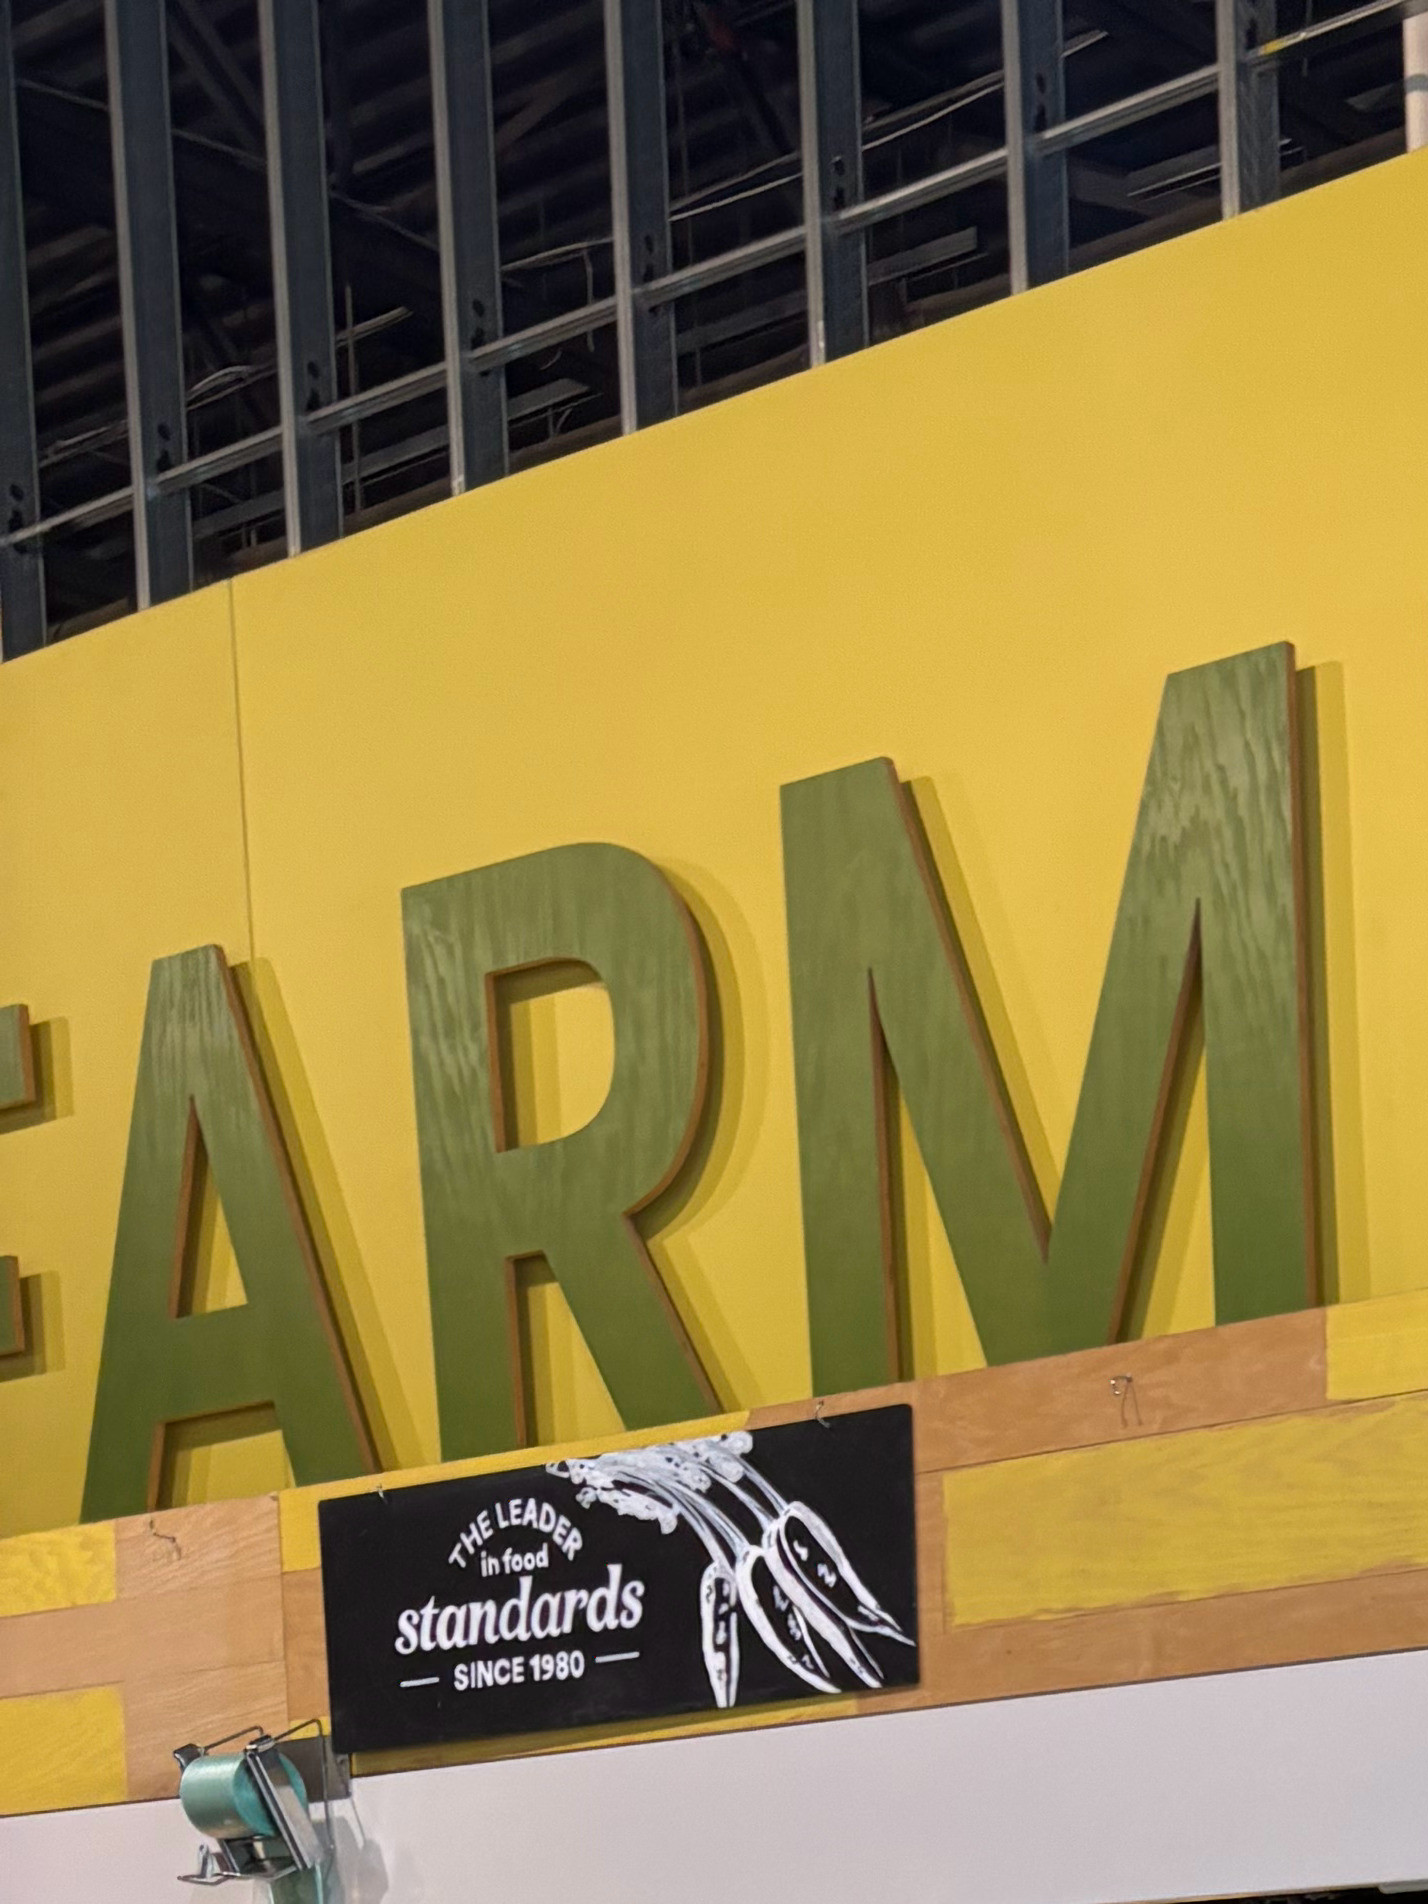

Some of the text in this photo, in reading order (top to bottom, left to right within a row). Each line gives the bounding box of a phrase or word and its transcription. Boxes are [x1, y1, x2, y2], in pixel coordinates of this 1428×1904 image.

[449, 1498, 584, 1569] THE LEADER
[480, 1544, 549, 1577] in food
[395, 1563, 646, 1655] standards
[453, 1650, 585, 1691] SINCE 1980
